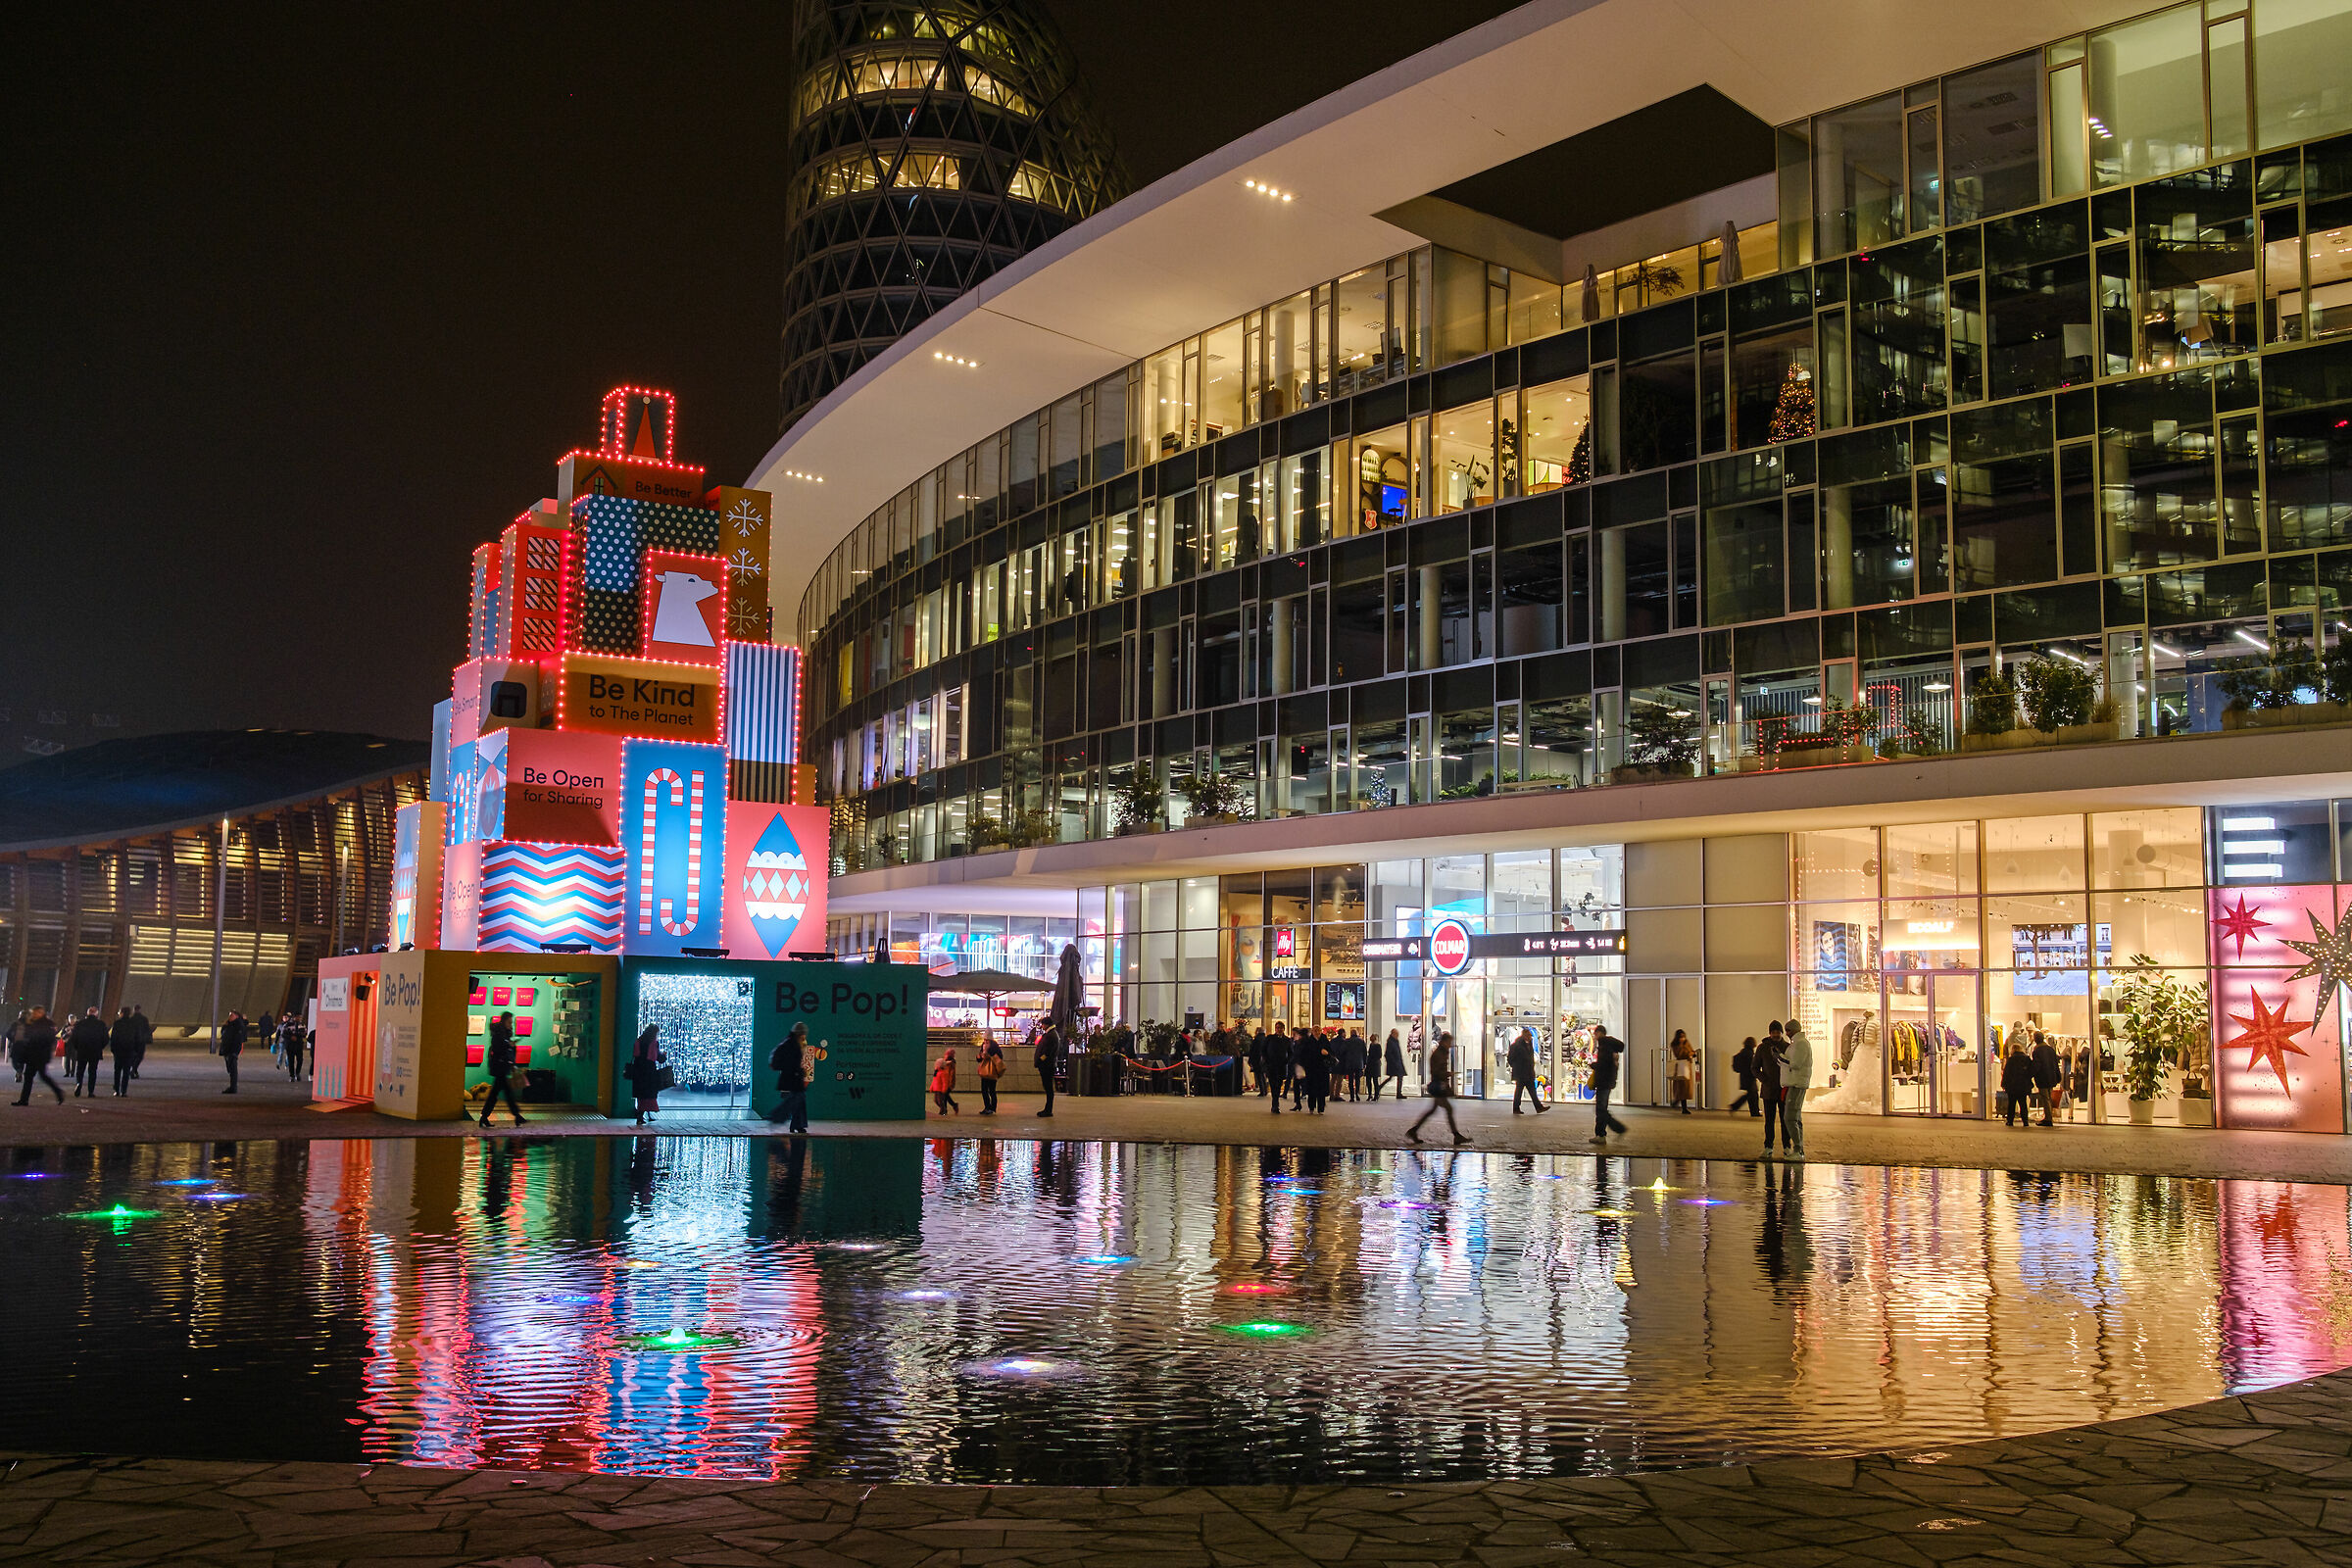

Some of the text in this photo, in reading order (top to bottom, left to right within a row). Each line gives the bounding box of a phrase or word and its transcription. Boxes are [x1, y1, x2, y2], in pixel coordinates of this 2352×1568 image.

[635, 481, 693, 499] Be Better
[589, 673, 695, 708] Be Kind
[589, 705, 694, 726] to The Planet
[523, 767, 604, 790] Be Open
[523, 788, 603, 809] for Sharing
[448, 880, 475, 903] Be Open
[1907, 921, 1954, 934] ECOALF
[1278, 935, 1291, 953] illy
[1434, 939, 1466, 956] COLMAR
[1271, 964, 1299, 979] CAFFÈ
[384, 971, 421, 1014] Be Pop!
[775, 982, 908, 1021] Be Pop!
